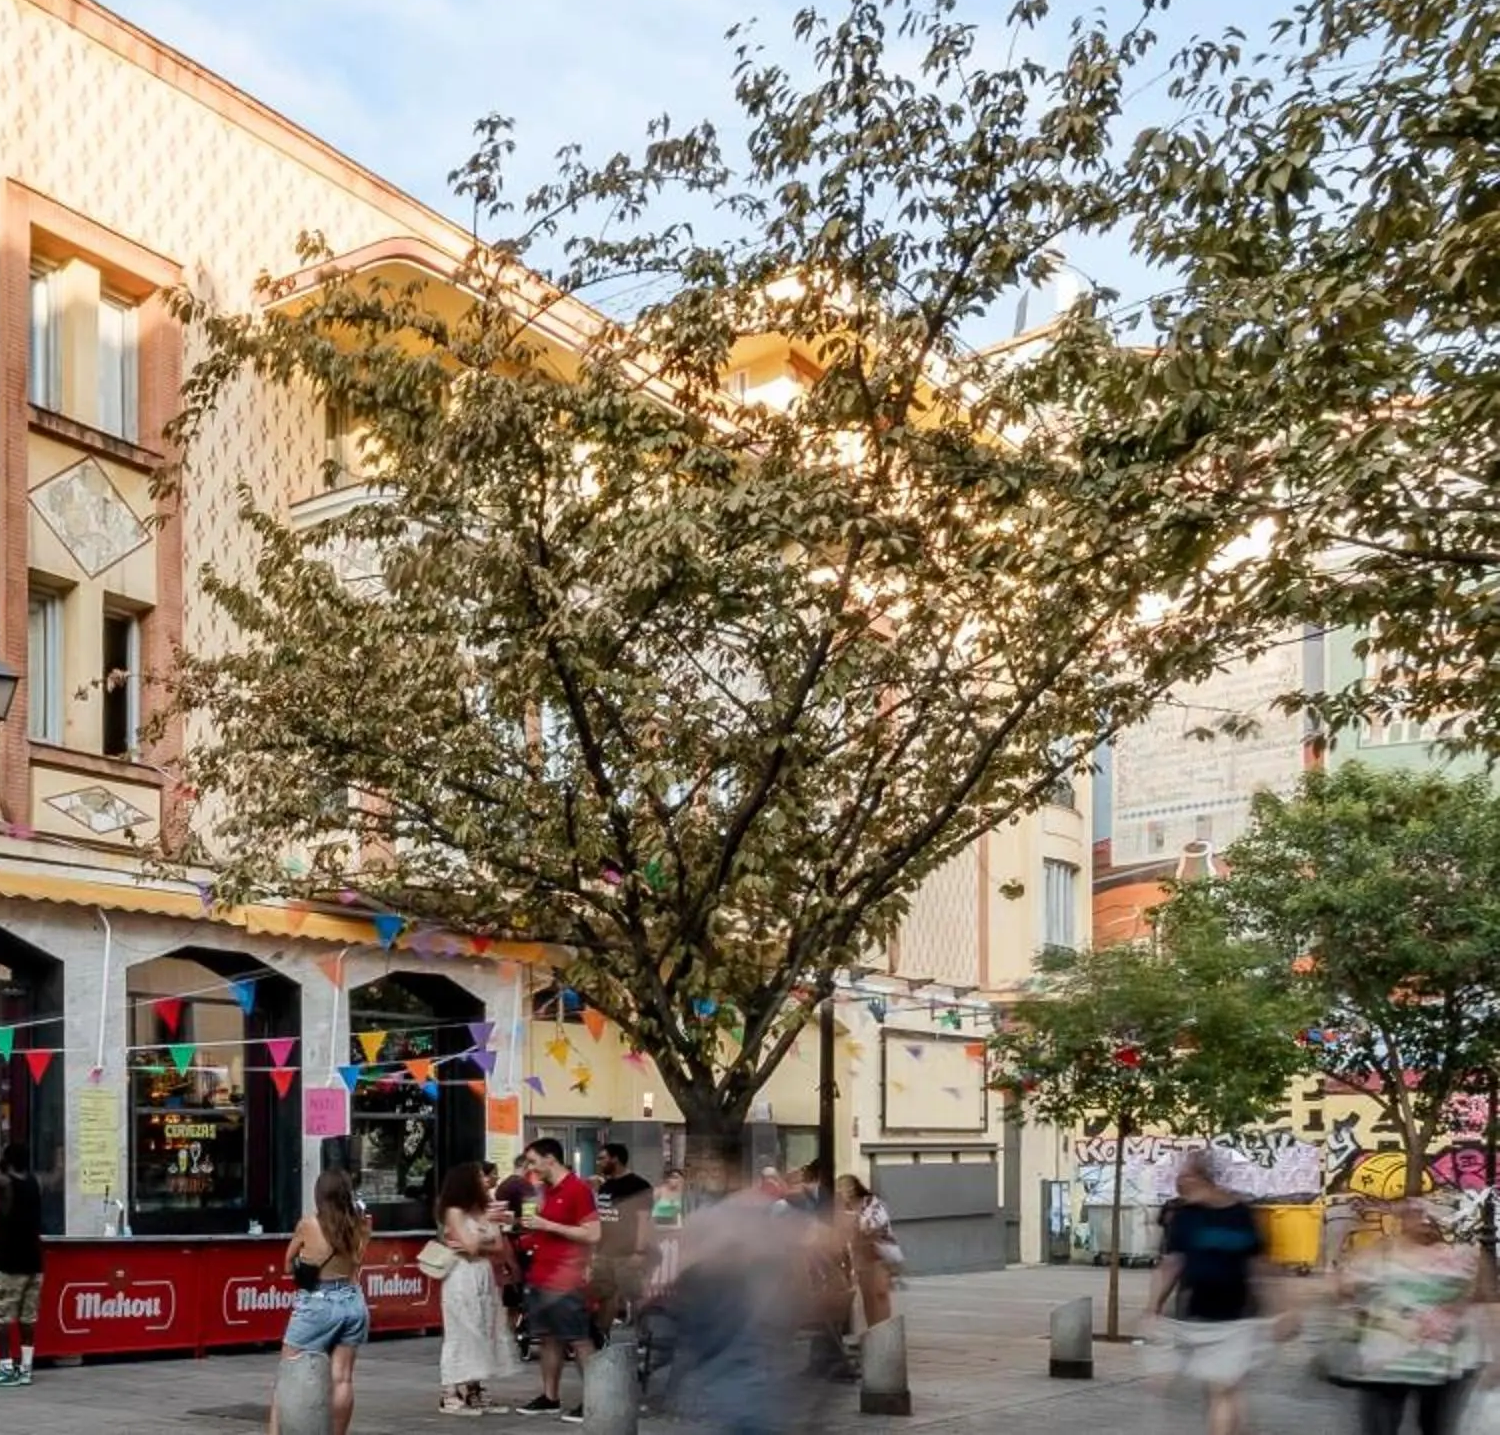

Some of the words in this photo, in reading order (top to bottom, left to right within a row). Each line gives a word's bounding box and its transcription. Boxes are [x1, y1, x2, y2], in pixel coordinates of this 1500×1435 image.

[236, 1284, 298, 1312] Maho
[367, 1273, 422, 1297] Mahou
[75, 1291, 162, 1320] Mahou
